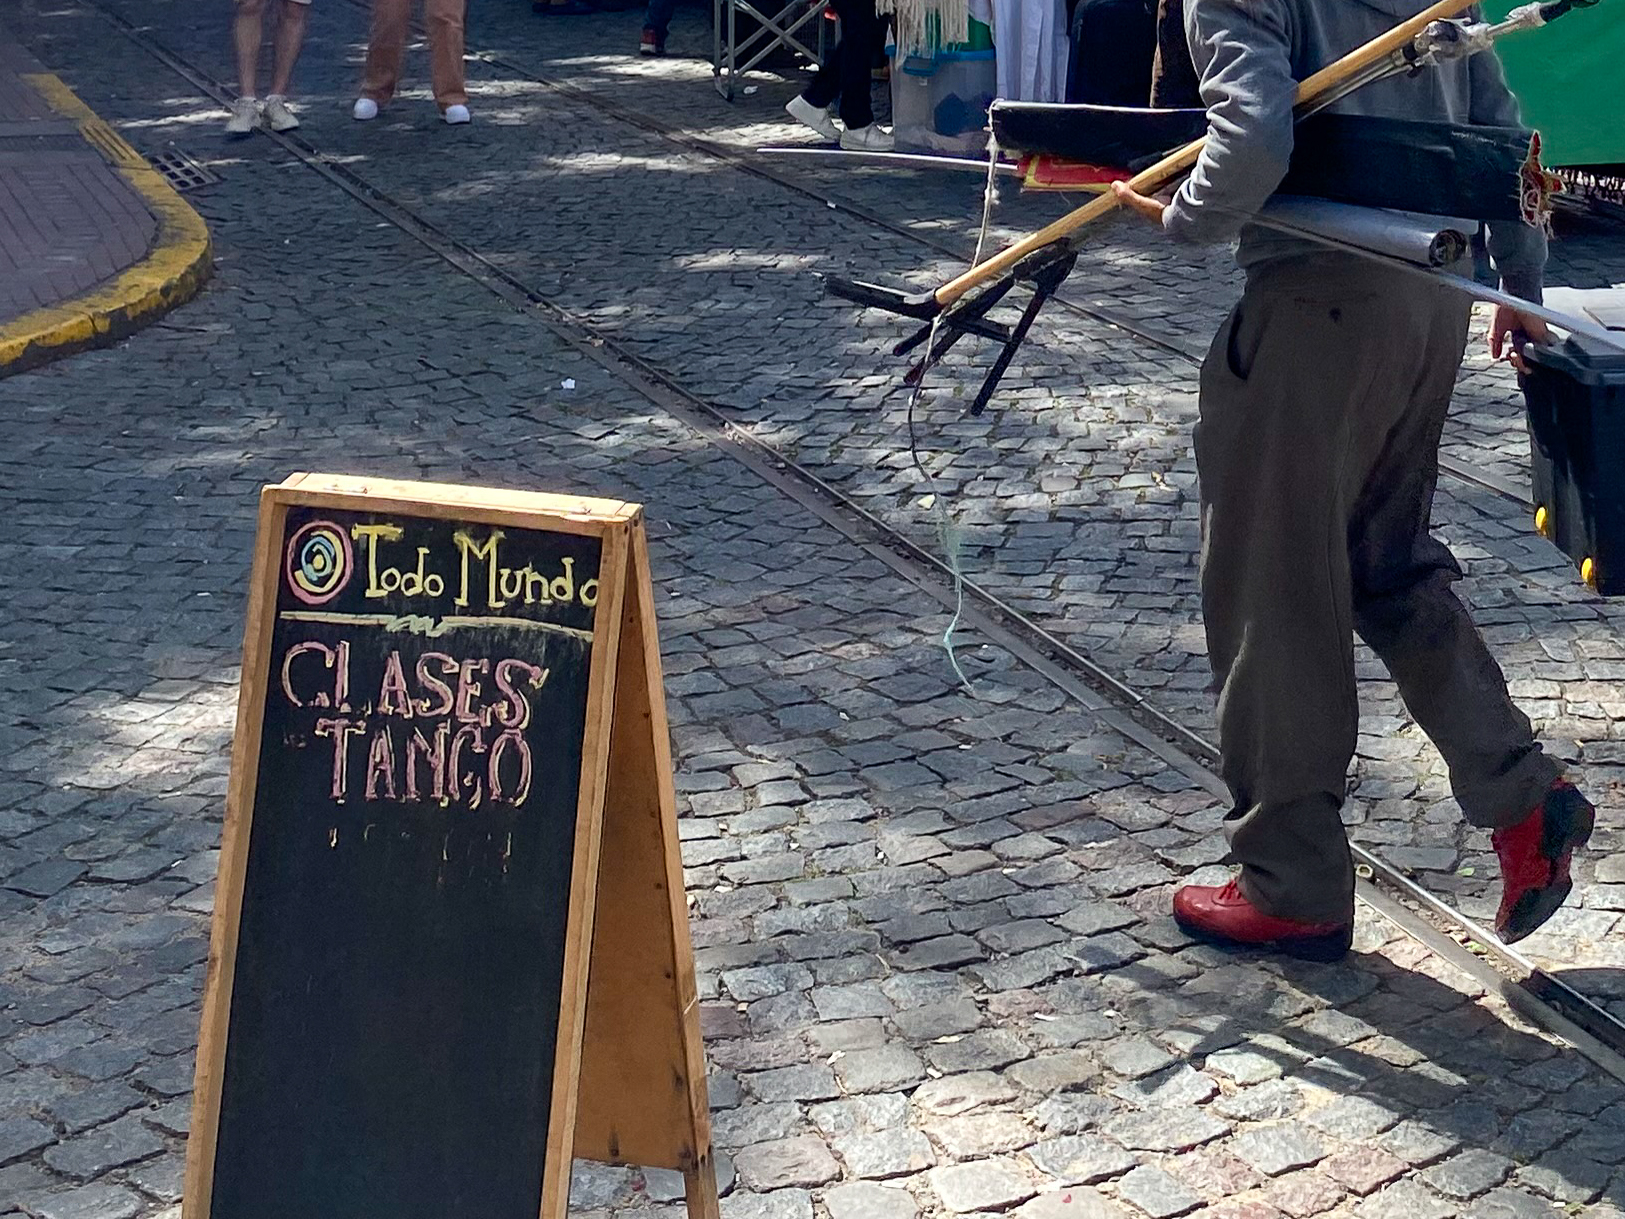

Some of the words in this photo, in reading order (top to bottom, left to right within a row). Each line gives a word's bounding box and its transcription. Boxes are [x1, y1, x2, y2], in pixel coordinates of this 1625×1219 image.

[351, 523, 445, 598] Todo
[453, 530, 599, 609] Mundo
[281, 640, 549, 730] CLASES
[315, 718, 533, 810] TANGO
